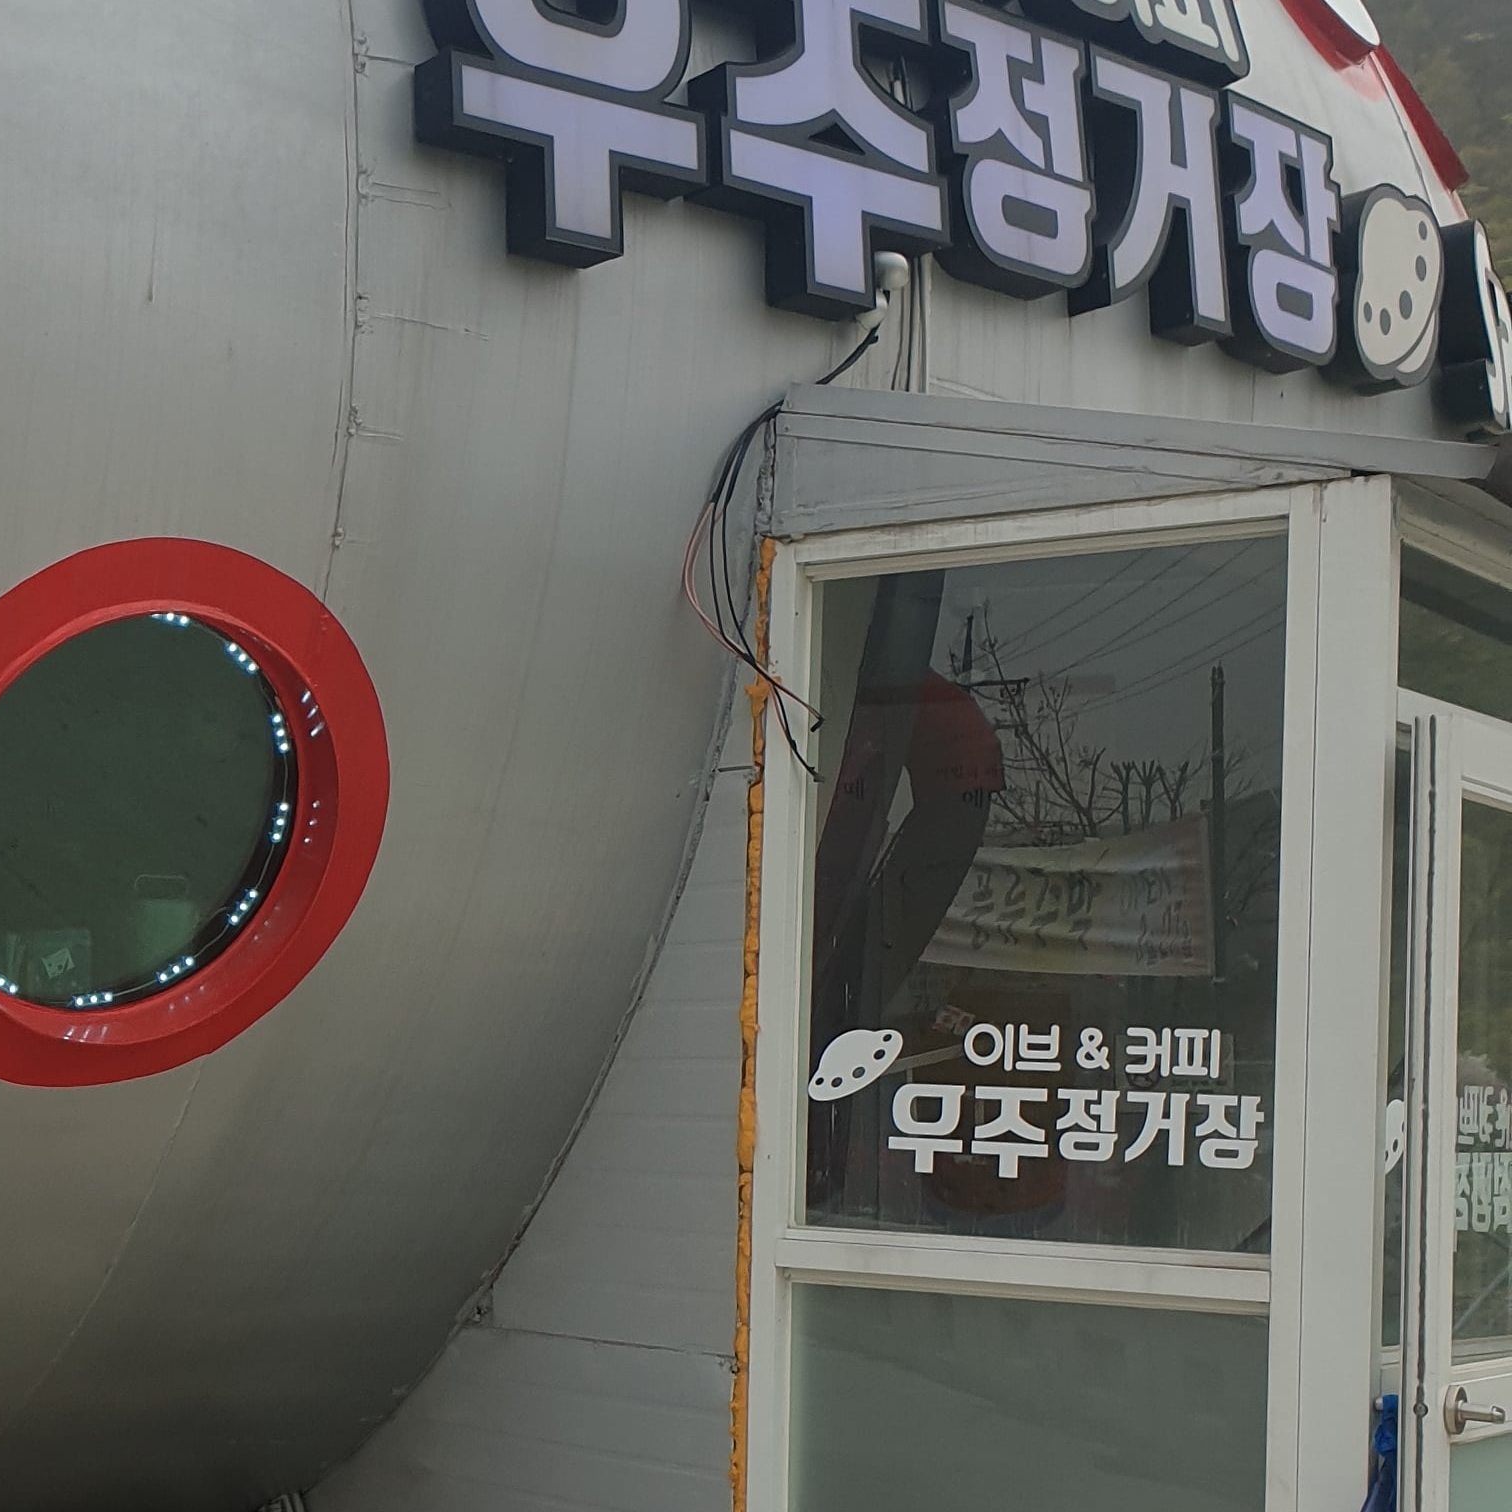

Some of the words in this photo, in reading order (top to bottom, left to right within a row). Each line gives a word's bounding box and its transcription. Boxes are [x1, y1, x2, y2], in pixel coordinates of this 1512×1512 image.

[448, 0, 1342, 364] 우주정거장
[963, 1022, 1062, 1073] 이브
[1075, 1026, 1111, 1071] &
[1124, 1026, 1222, 1080] 커피
[887, 1082, 1265, 1180] 우주정거장
